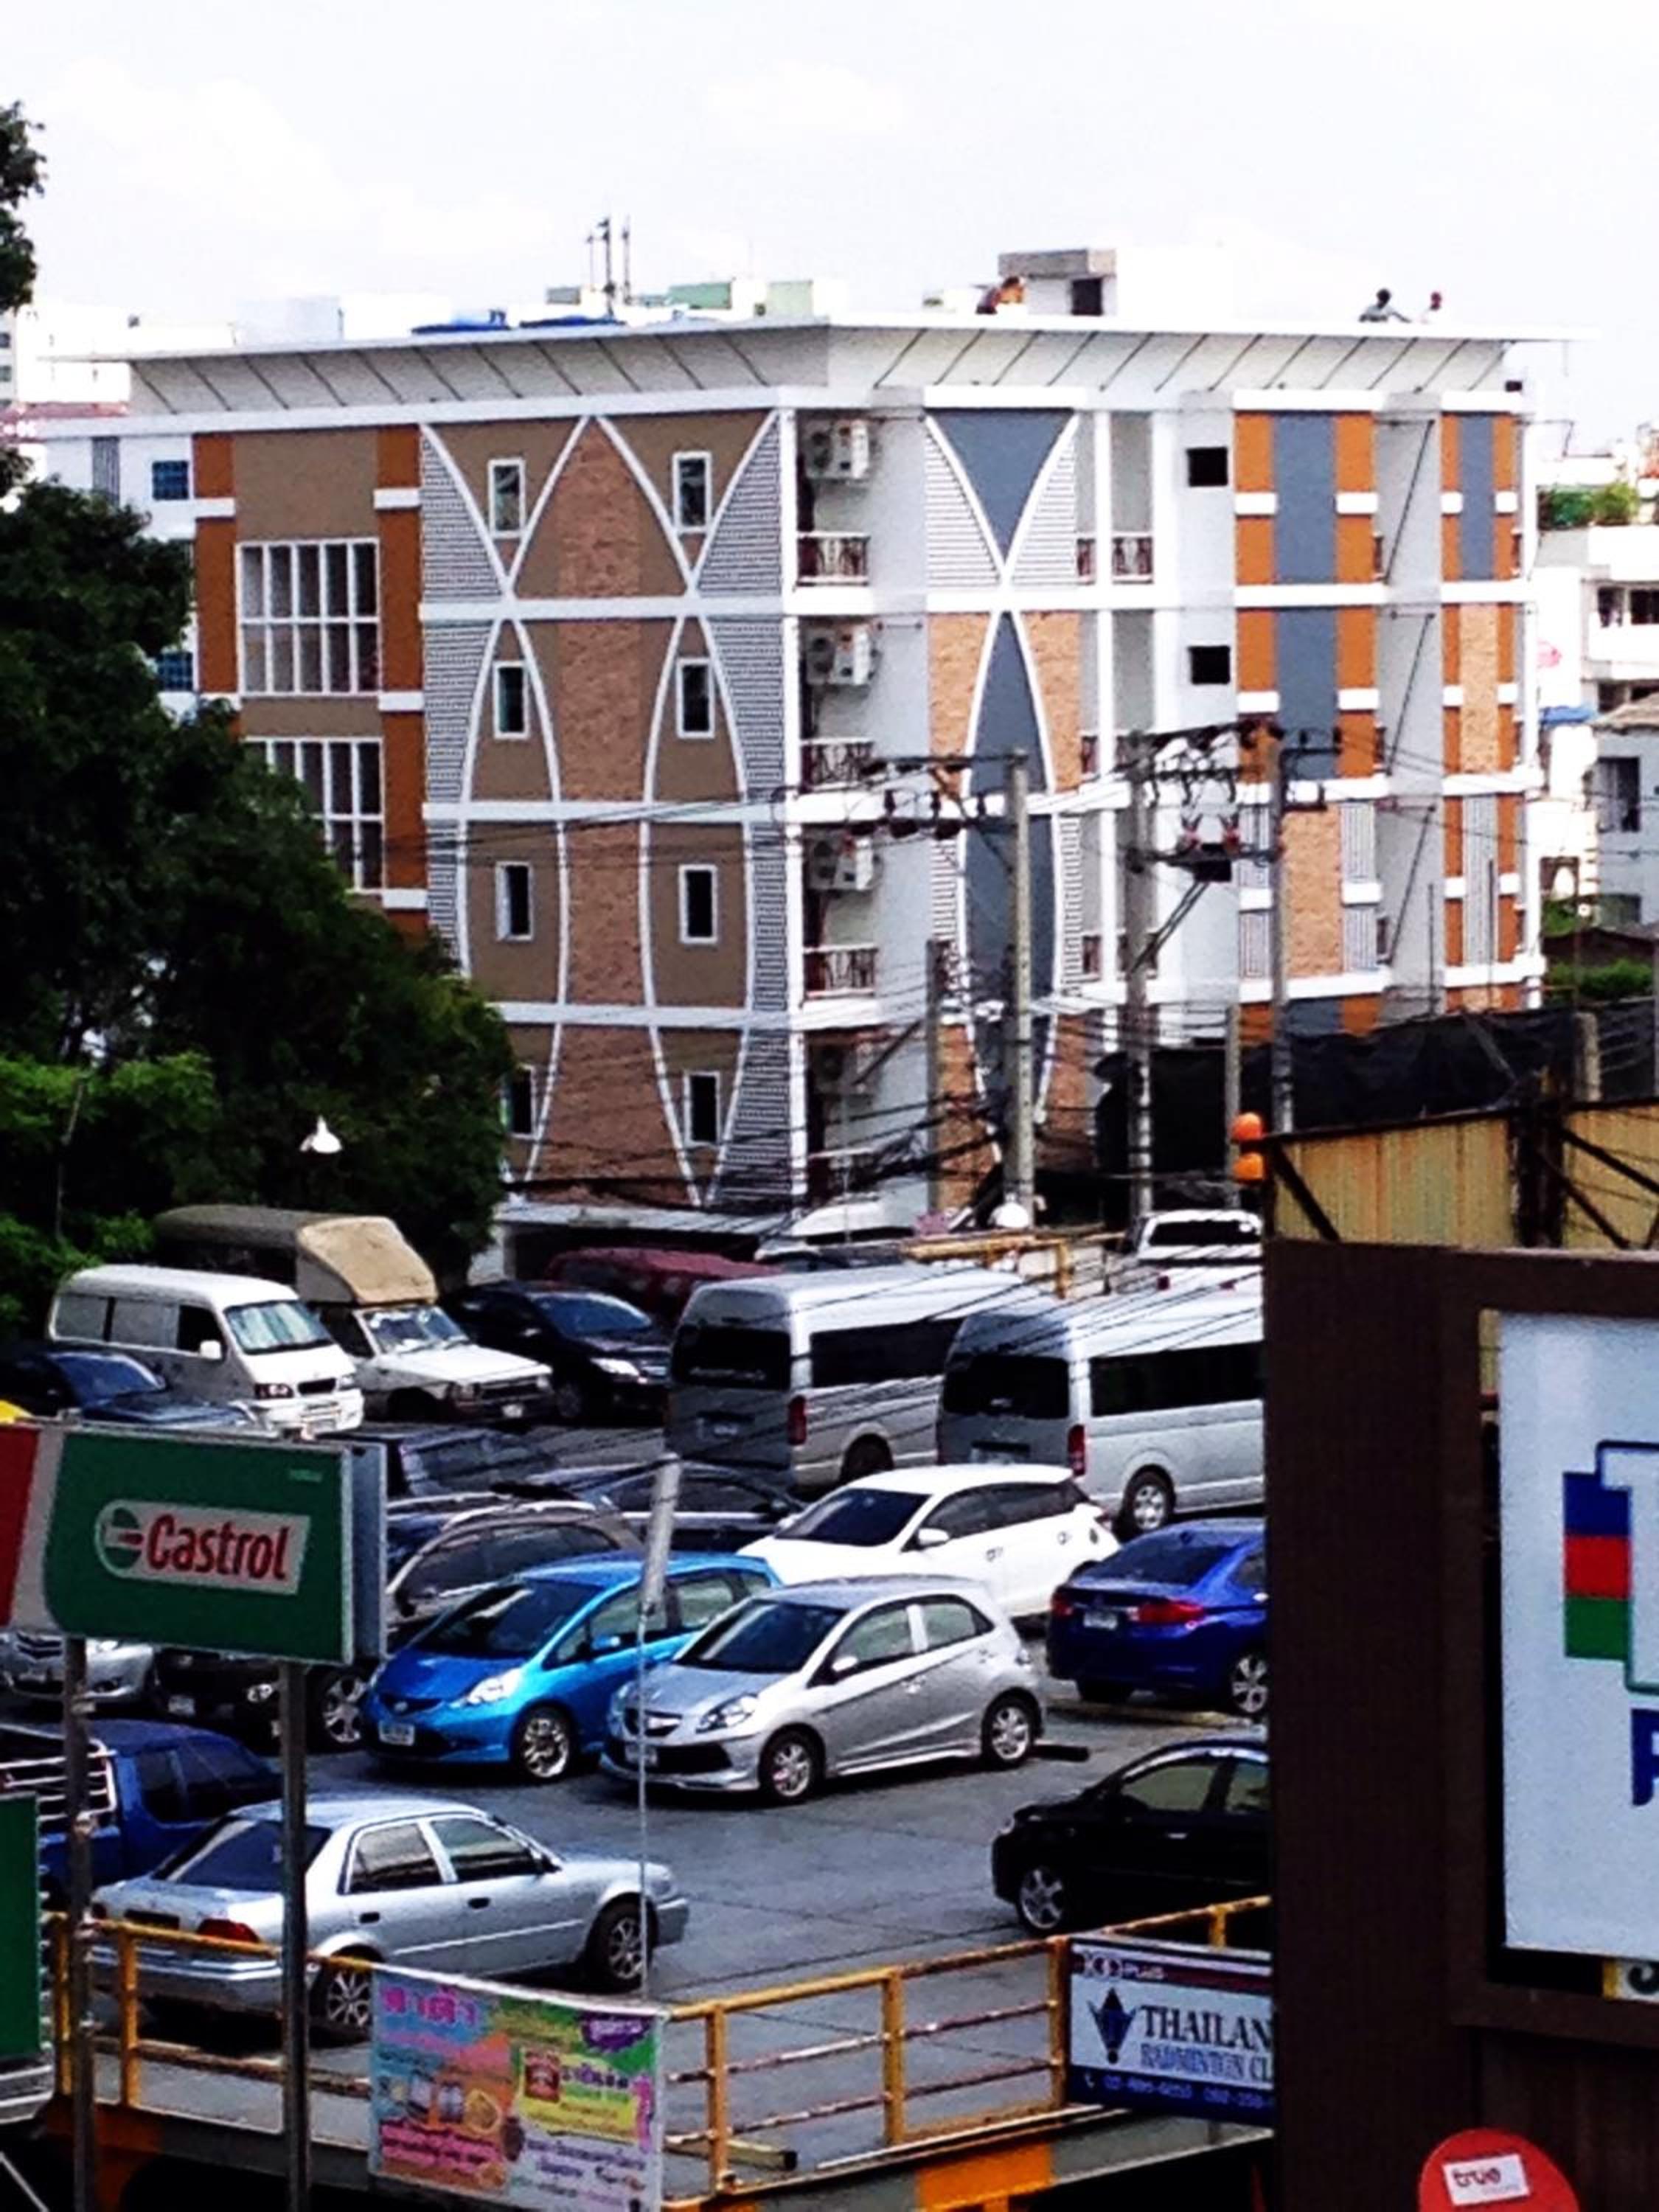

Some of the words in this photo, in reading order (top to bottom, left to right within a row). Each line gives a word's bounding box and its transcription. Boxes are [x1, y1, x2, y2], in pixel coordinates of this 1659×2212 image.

[147, 1514, 290, 1580] Castrol
[1141, 2043, 1246, 2079] BADMINTON
[1452, 2167, 1501, 2188] true
